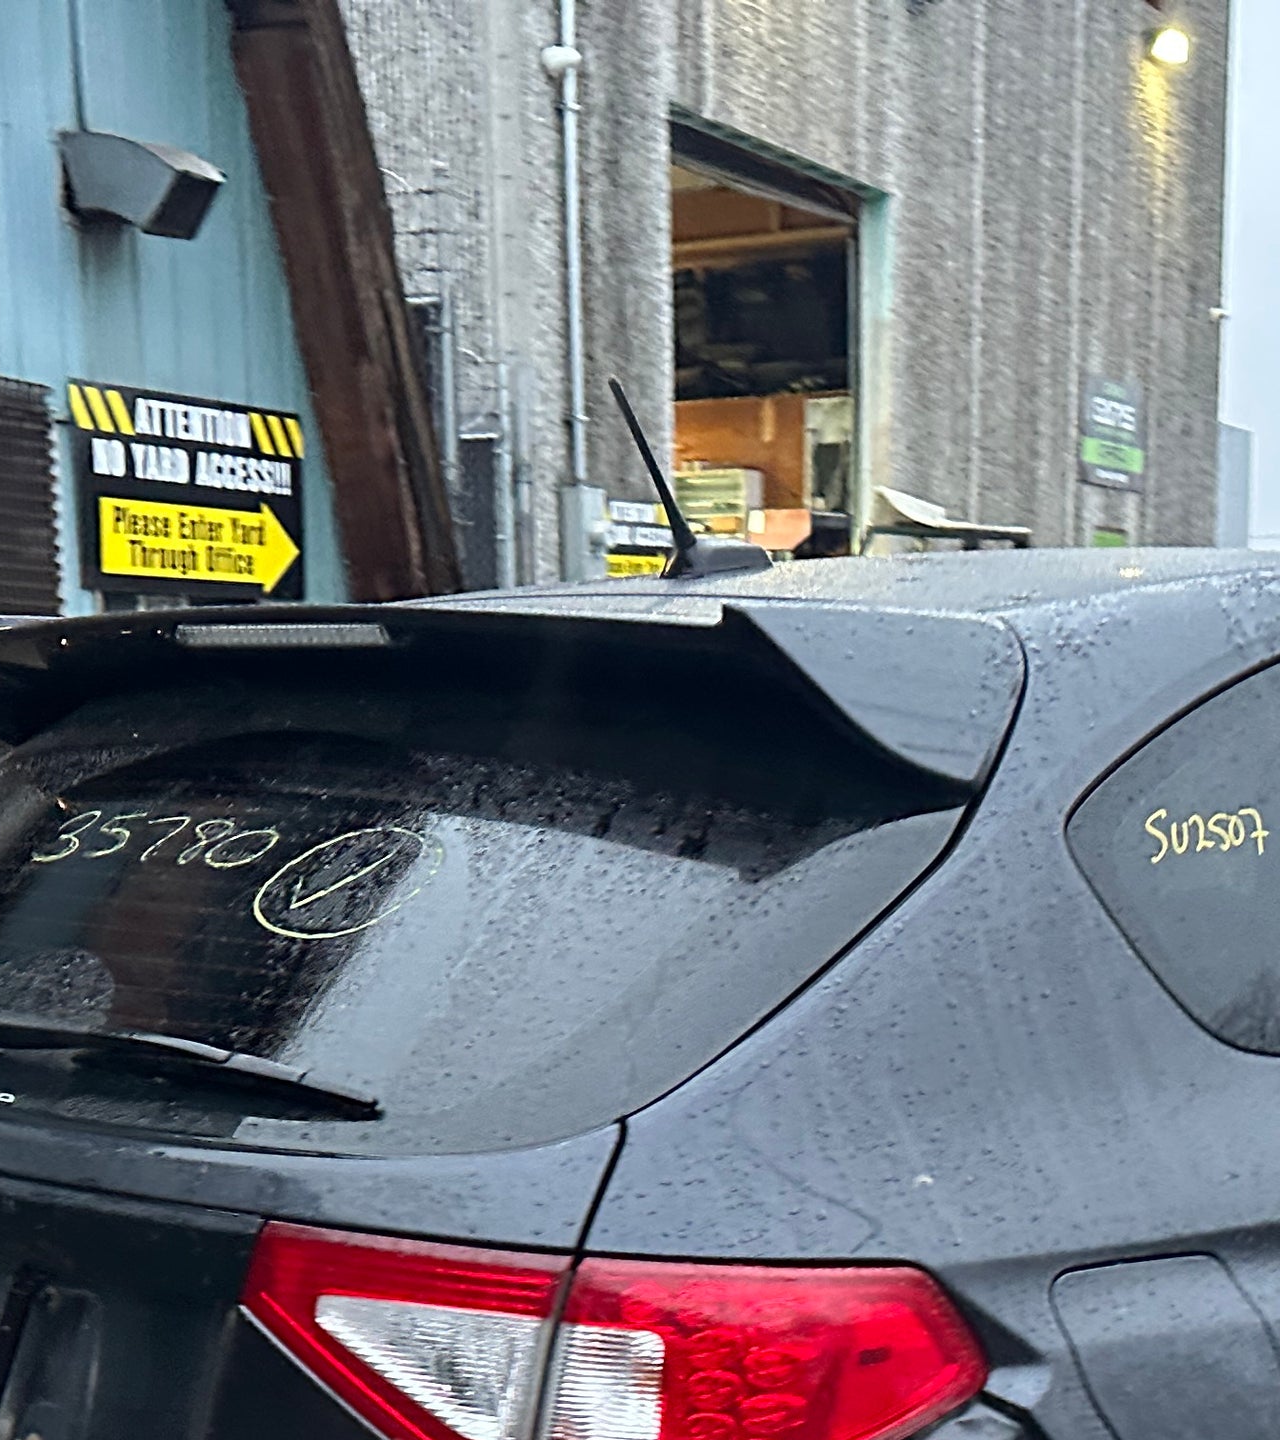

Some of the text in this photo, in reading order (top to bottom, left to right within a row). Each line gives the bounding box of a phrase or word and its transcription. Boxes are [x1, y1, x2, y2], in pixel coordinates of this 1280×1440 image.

[134, 397, 252, 449] ATTENTION
[91, 437, 127, 477] NO
[130, 442, 190, 484] YARD
[113, 505, 266, 546] Please Enter Yard
[128, 539, 255, 575] Through Office
[30, 809, 281, 869] 35780
[1144, 807, 1270, 865] SU2507
